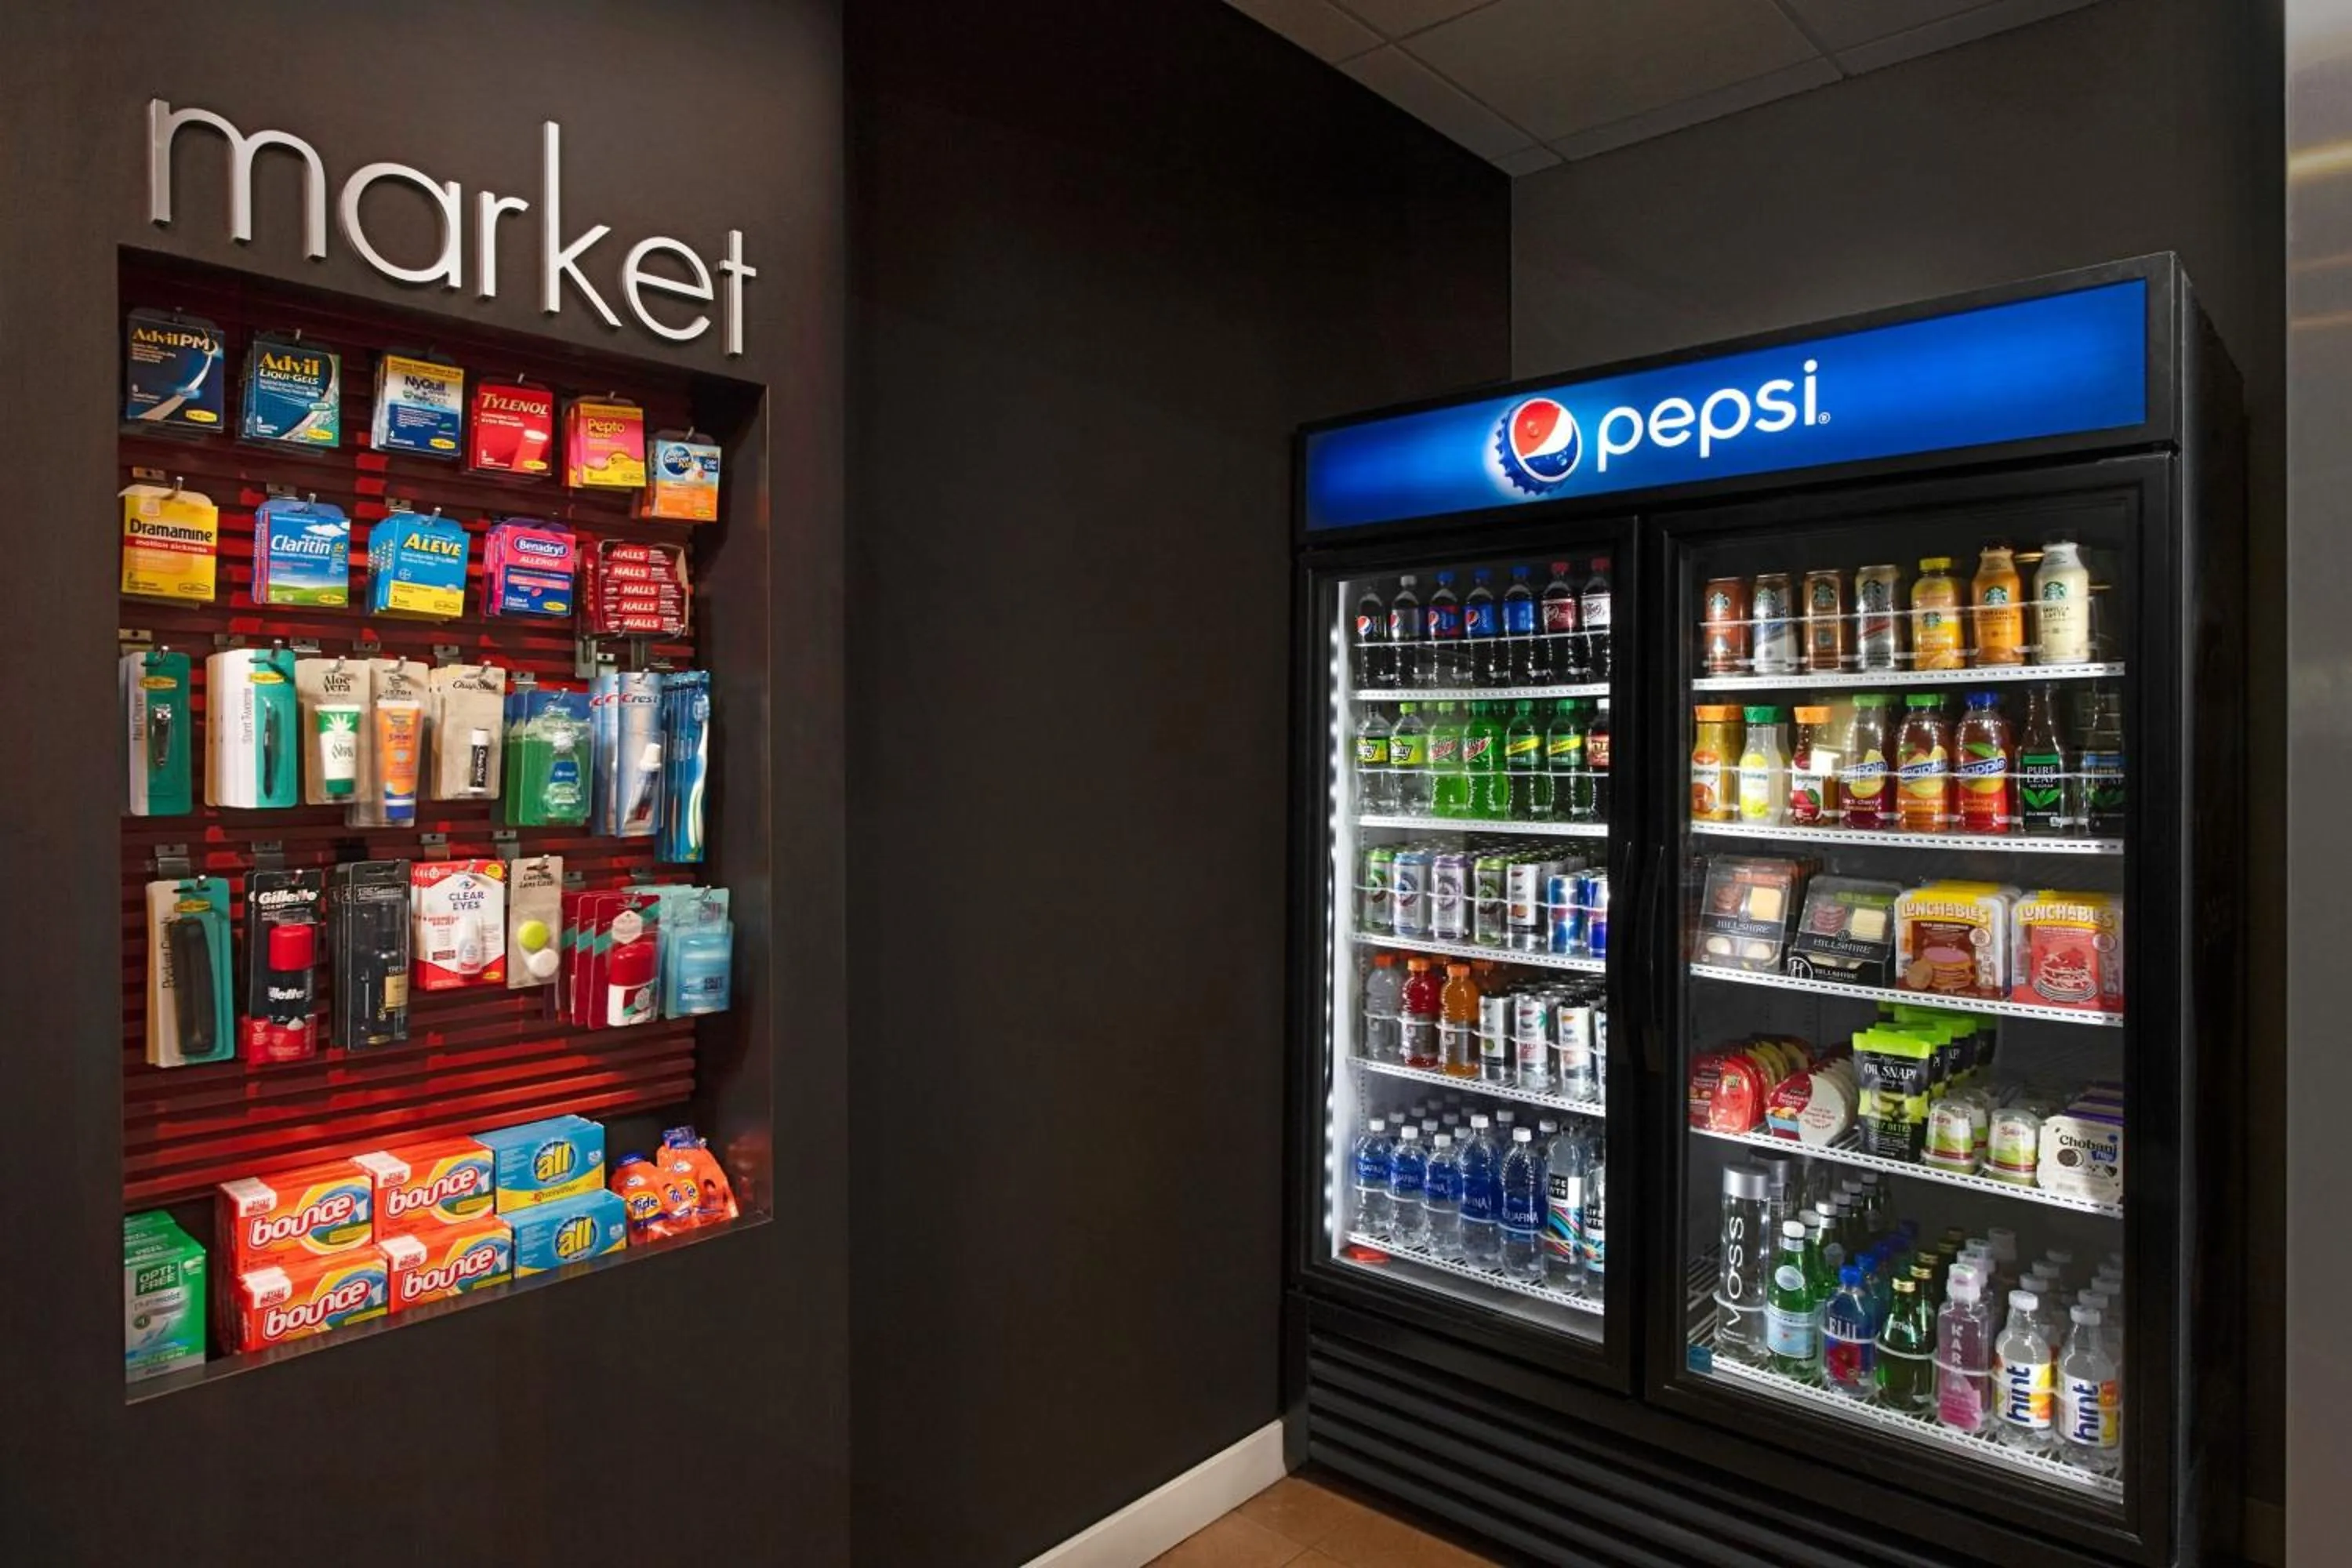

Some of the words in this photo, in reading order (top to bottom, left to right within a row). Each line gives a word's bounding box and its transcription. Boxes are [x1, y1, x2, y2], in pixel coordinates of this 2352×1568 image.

[148, 97, 758, 356] market
[132, 327, 179, 347] Advil
[179, 334, 210, 350] PM
[258, 351, 321, 376] Advil
[404, 375, 447, 391] NyQuil
[480, 393, 550, 416] TYLENOL
[1596, 358, 1819, 473] pepsi
[587, 418, 626, 434] Pepto
[129, 518, 213, 543] Dramamine
[270, 534, 331, 556] Claritin
[402, 532, 463, 557] ALEVE
[518, 539, 564, 557] Benadryl
[614, 566, 647, 578] HALLS
[622, 585, 656, 595] HALLS
[621, 602, 655, 612] HALLS
[322, 674, 352, 684] Aloe
[323, 682, 351, 693] Vera
[619, 693, 659, 704] Crest
[2026, 765, 2056, 775] PURE
[258, 888, 318, 906] Gillette
[448, 891, 485, 902] CLEAR
[452, 900, 481, 910] EYES
[1903, 901, 1989, 923] LUNCHABLES
[2020, 903, 2116, 927] LUNCHABLES
[1715, 920, 1772, 934] HILLSHIRE
[1813, 938, 1874, 955] HILLSHIRE
[1815, 967, 1858, 980] HILLSHIRE
[2059, 1134, 2117, 1152] Chobani
[536, 1141, 570, 1180] all
[388, 1167, 477, 1216] bounce
[669, 1184, 696, 1202] Tie
[632, 1197, 659, 1214] Tide
[250, 1196, 353, 1247] bounce
[558, 1216, 592, 1256] all
[403, 1248, 495, 1299] bounce
[264, 1279, 368, 1339] bounce
[2006, 1364, 2031, 1423] hint
[2072, 1384, 2100, 1442] hint
